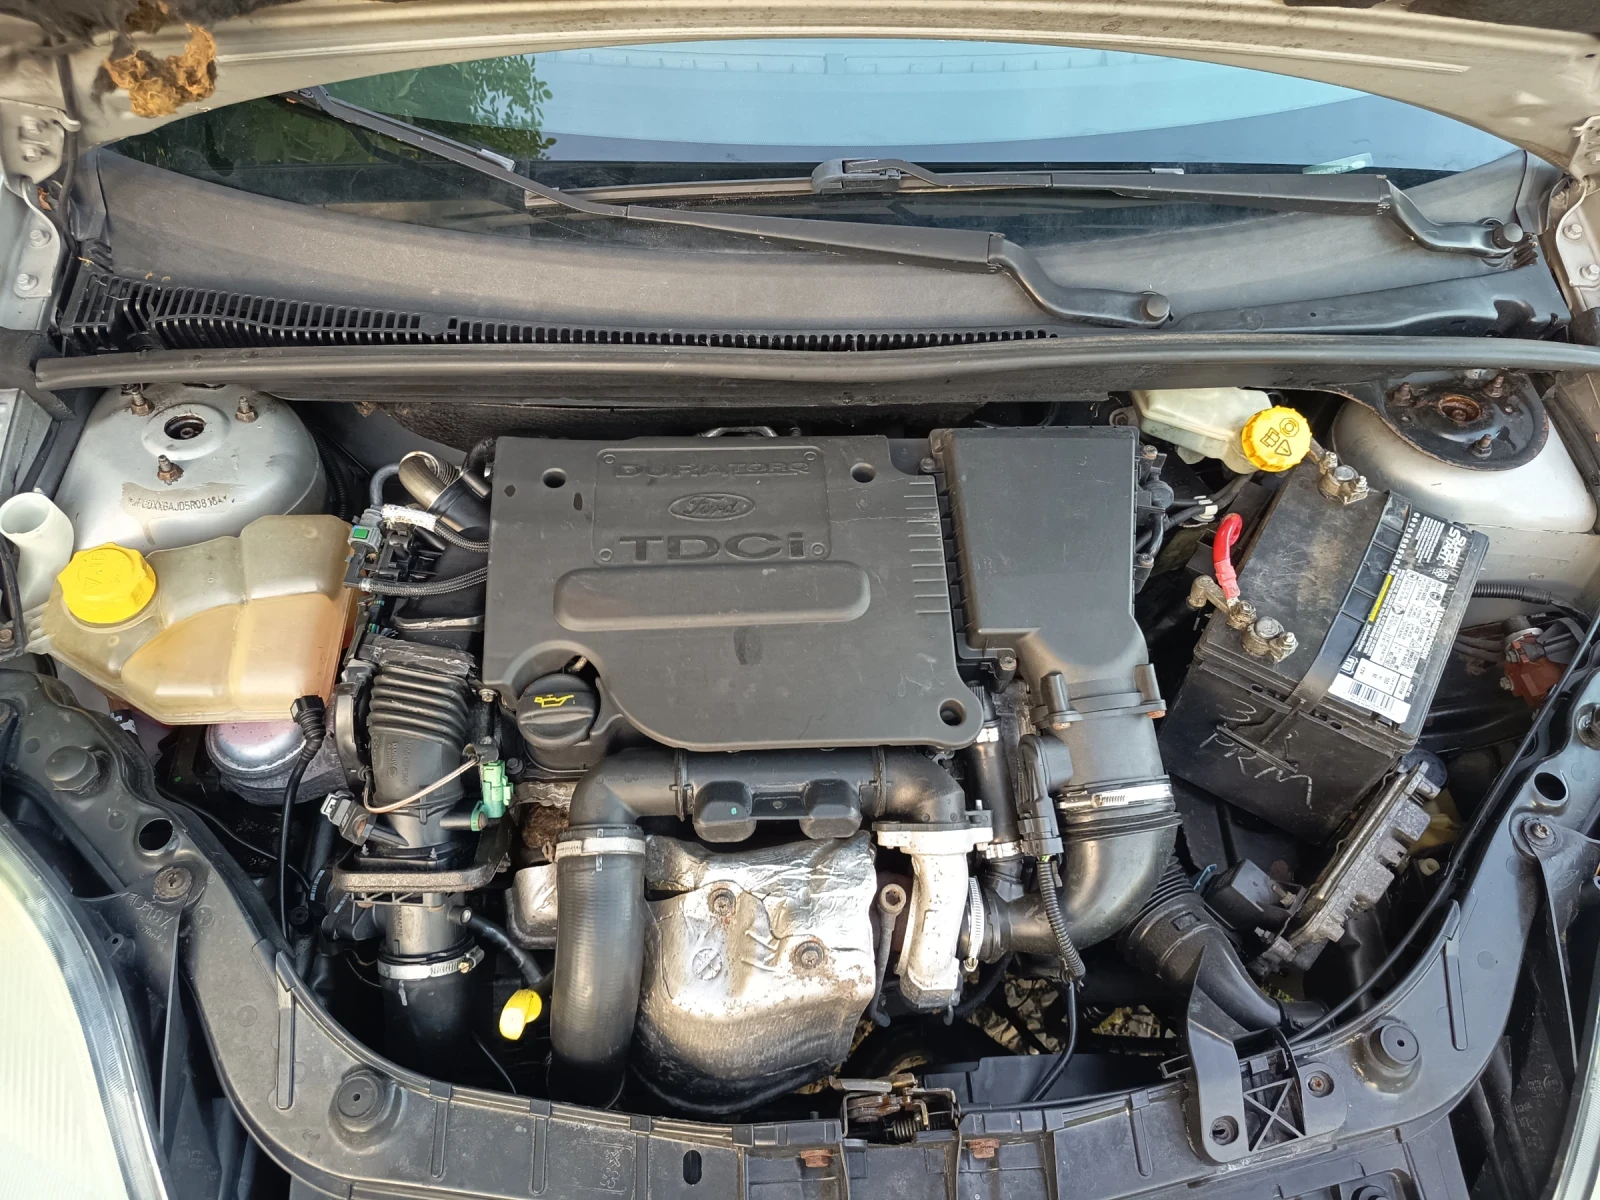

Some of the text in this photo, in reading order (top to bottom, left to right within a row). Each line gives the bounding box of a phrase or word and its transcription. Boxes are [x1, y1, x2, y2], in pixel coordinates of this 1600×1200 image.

[615, 461, 810, 478] DURATORQ
[680, 495, 741, 517] Ford
[619, 532, 806, 564] TDCi
[1437, 526, 1461, 562] START
[1447, 533, 1467, 567] SUPER
